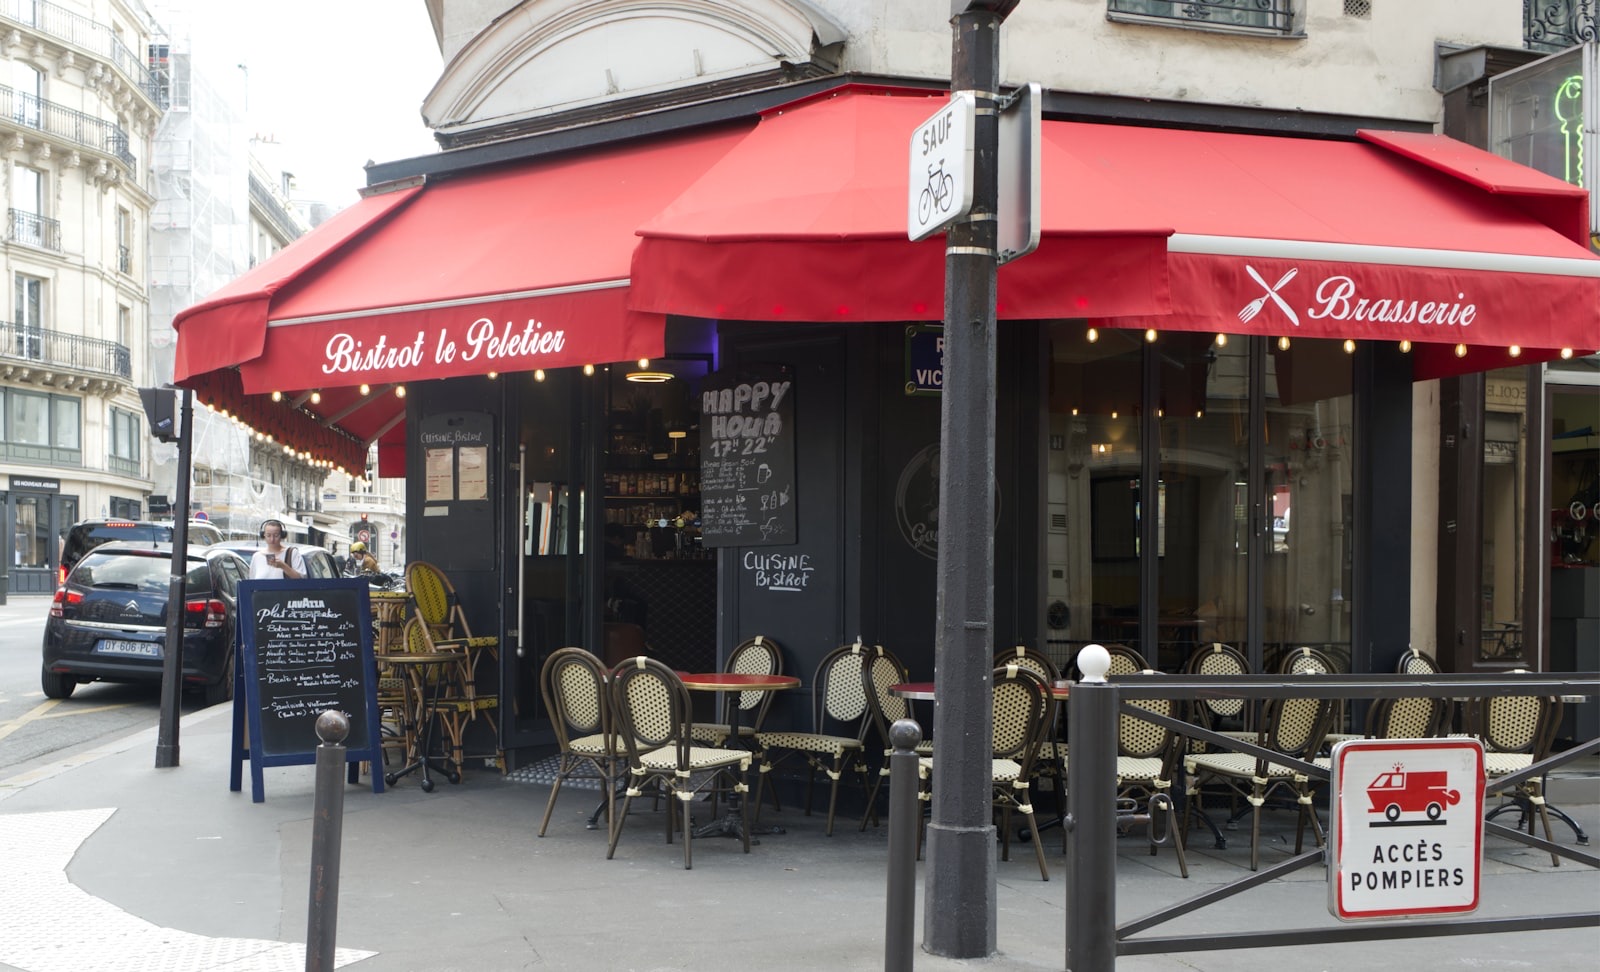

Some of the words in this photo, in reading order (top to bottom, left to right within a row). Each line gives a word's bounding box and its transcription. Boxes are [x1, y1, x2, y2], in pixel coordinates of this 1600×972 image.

[922, 111, 953, 156] SAUF
[1307, 275, 1476, 326] Brasserie
[321, 330, 425, 375] Bistrot
[434, 328, 457, 365] le
[461, 317, 566, 361] Peletier
[916, 369, 943, 386] VIC
[703, 381, 791, 414] HAPPY
[711, 412, 782, 439] HOUR
[287, 597, 325, 609] LAVAZZA
[1372, 839, 1442, 863] ACCÈS
[1351, 867, 1464, 891] POMPIERS
